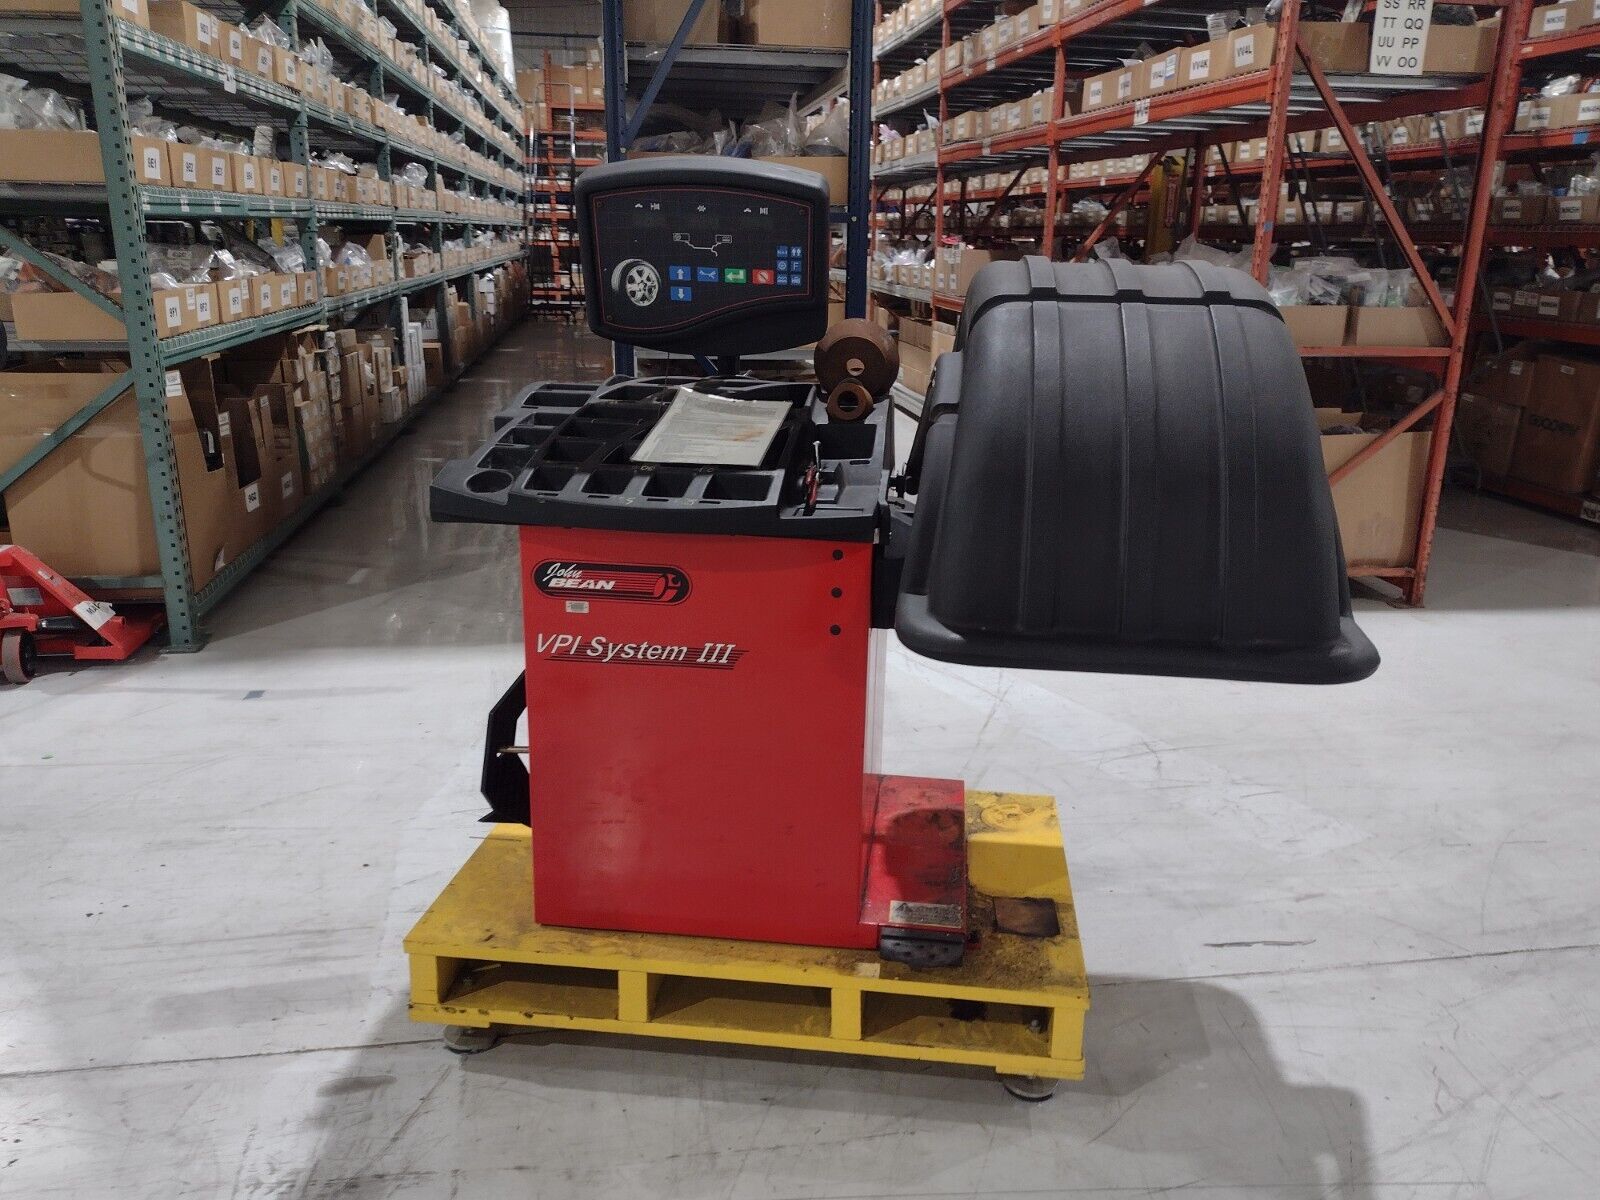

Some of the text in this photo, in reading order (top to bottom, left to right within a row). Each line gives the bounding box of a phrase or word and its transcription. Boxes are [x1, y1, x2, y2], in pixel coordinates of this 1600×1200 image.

[1384, 0, 1426, 10] SS RR
[1382, 16, 1424, 30] TT QQ
[1378, 36, 1420, 48] UU PP
[542, 562, 582, 581] John
[548, 577, 616, 590] BEAN
[537, 633, 736, 664] VPI System III
